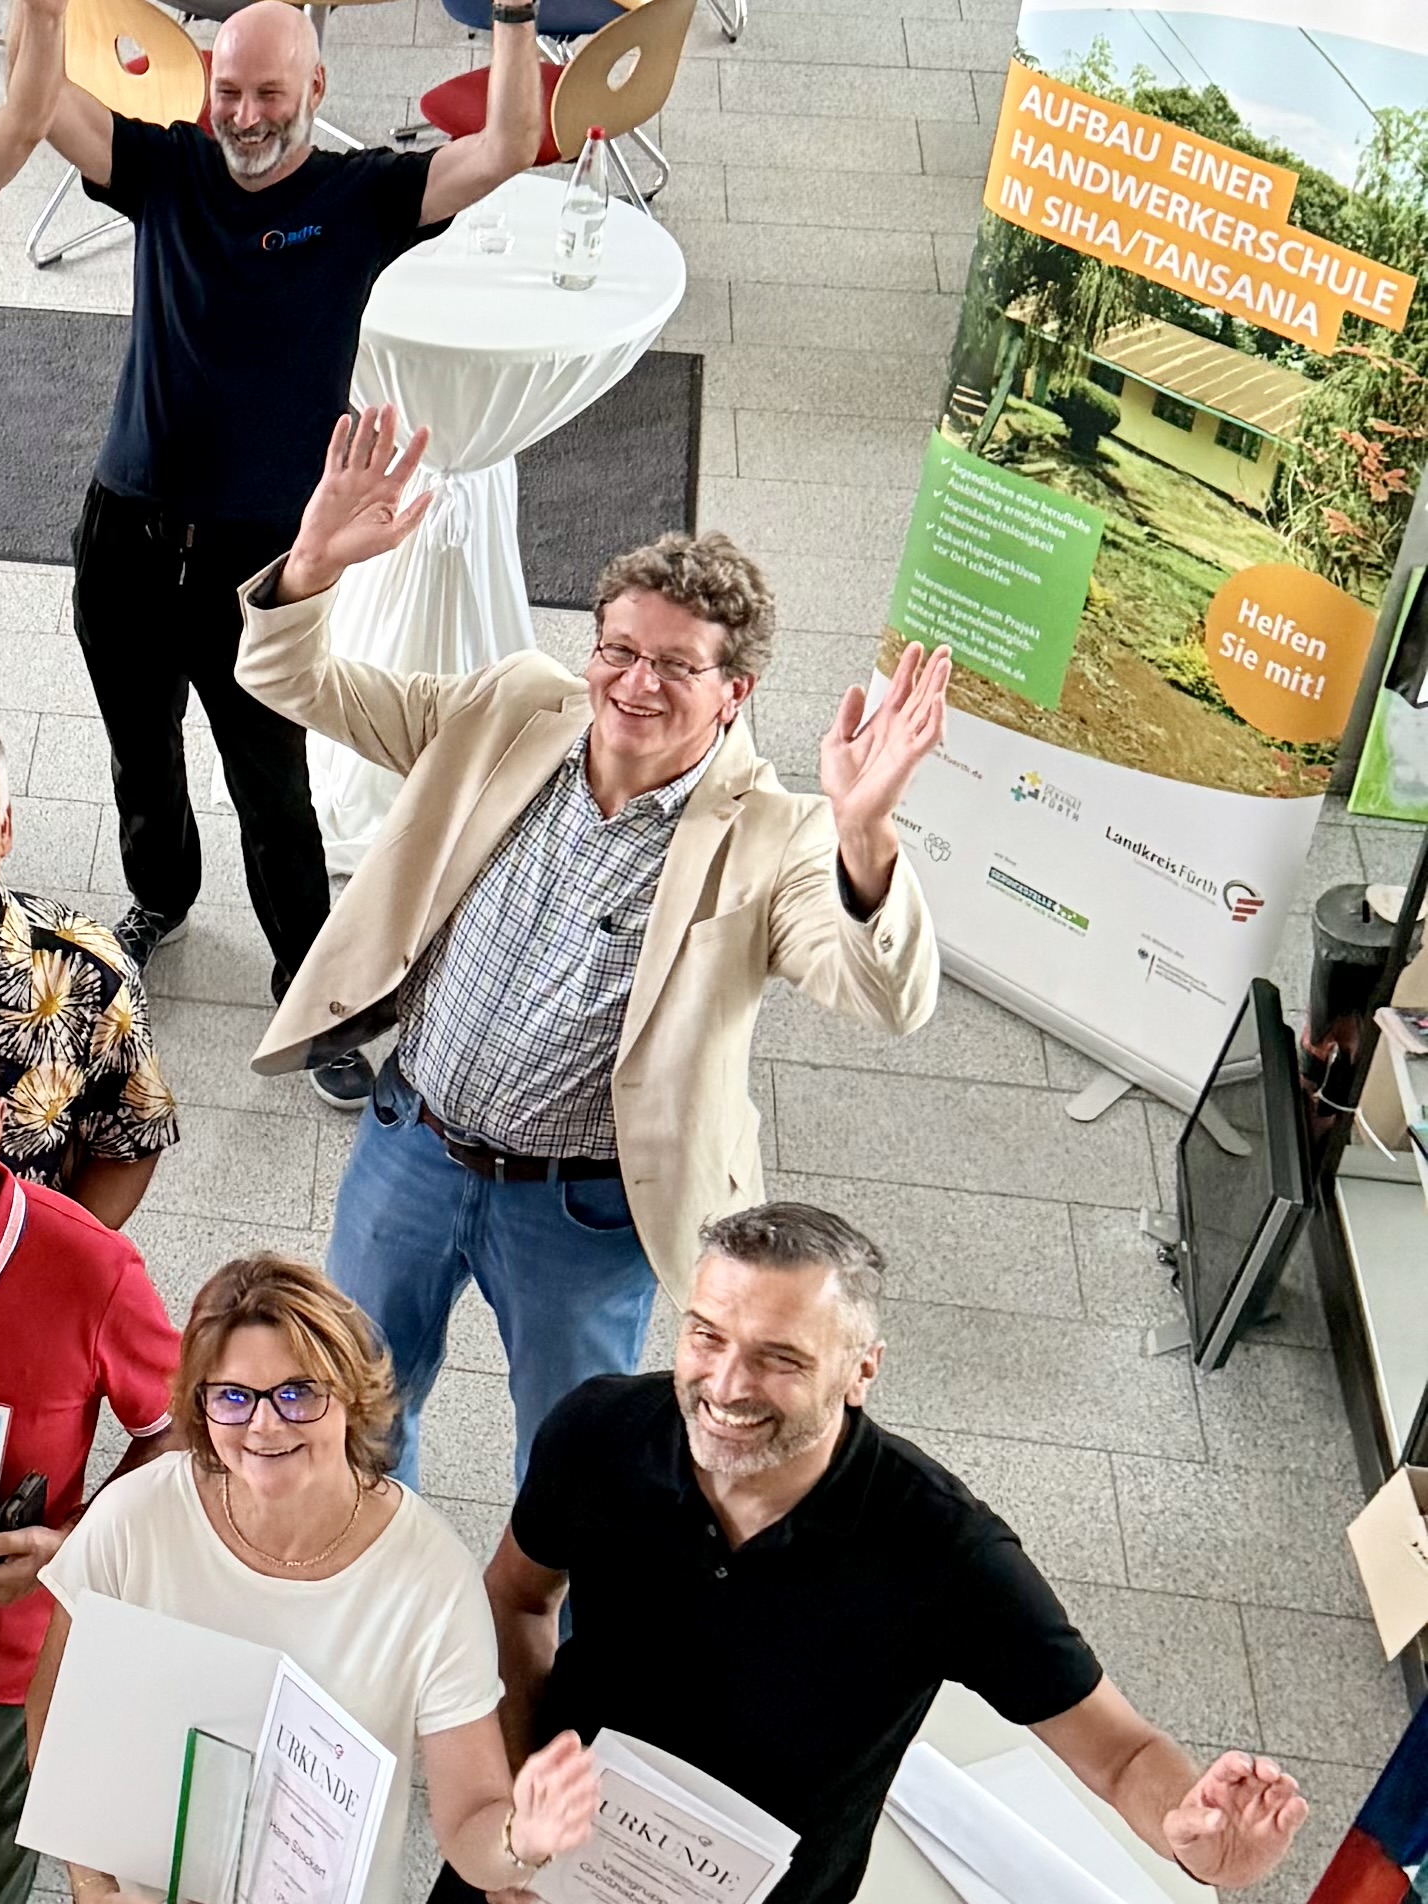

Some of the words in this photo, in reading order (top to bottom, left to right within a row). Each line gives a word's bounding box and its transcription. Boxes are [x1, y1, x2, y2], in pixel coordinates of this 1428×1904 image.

[1019, 84, 1162, 164] AUFBAU
[1169, 141, 1274, 209] EINER
[1000, 174, 1034, 217] IN
[1040, 195, 1320, 338] SIHA/TANSANIA
[1010, 129, 1399, 315] HANDWERKERSCHULE
[1218, 631, 1259, 671] Sie
[1264, 660, 1326, 700] mit!
[1237, 597, 1327, 661] Helfen
[1105, 826, 1177, 875] Landkreis
[1178, 864, 1218, 896] Fürth
[276, 1724, 360, 1818] URKUNDE
[598, 1799, 742, 1893] URKUNDE
